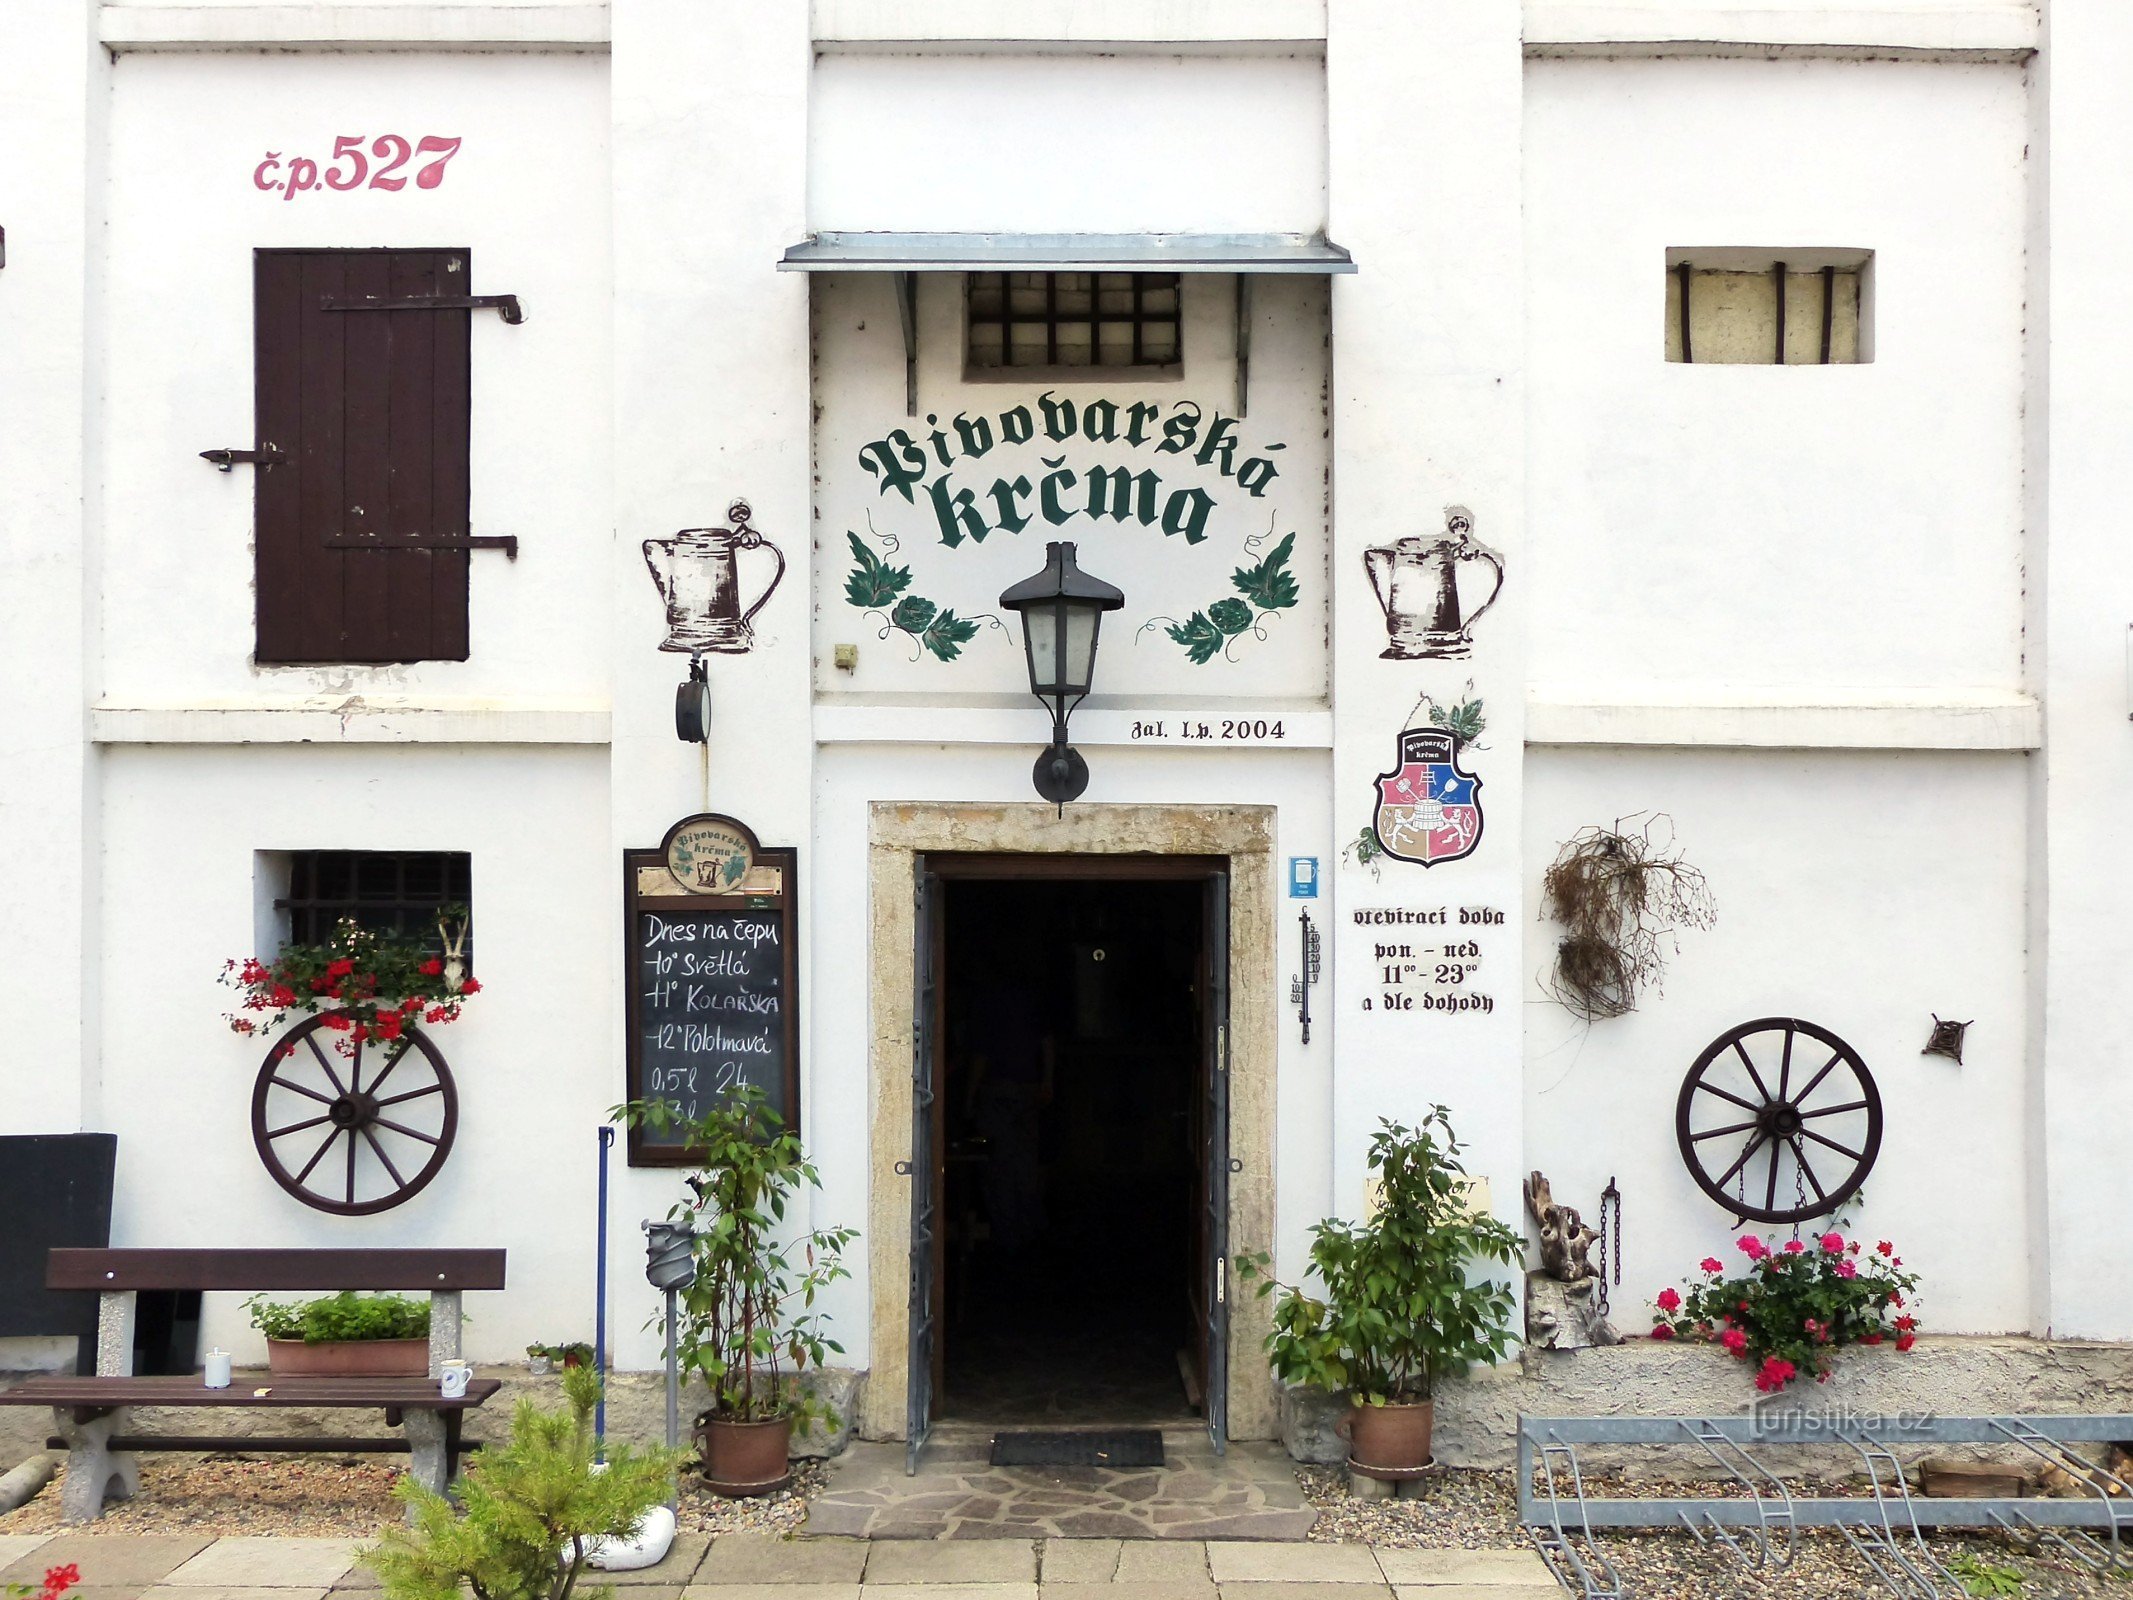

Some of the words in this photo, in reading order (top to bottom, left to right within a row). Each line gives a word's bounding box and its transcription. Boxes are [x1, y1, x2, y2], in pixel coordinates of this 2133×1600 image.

[858, 390, 1287, 505] Pivovarská
[922, 454, 1219, 550] krčma
[1221, 720, 1285, 739] 2004
[1459, 906, 1505, 925] doba
[644, 914, 697, 948] Dnes
[702, 922, 730, 940] na
[732, 919, 779, 949] čepu
[680, 950, 751, 976] Světlá
[1374, 942, 1416, 962] pon.
[1443, 939, 1482, 958] ned.
[1362, 996, 1373, 1011] a
[1384, 991, 1413, 1011] dle
[1422, 991, 1494, 1015] dohody
[684, 1023, 772, 1054] Polotmavá
